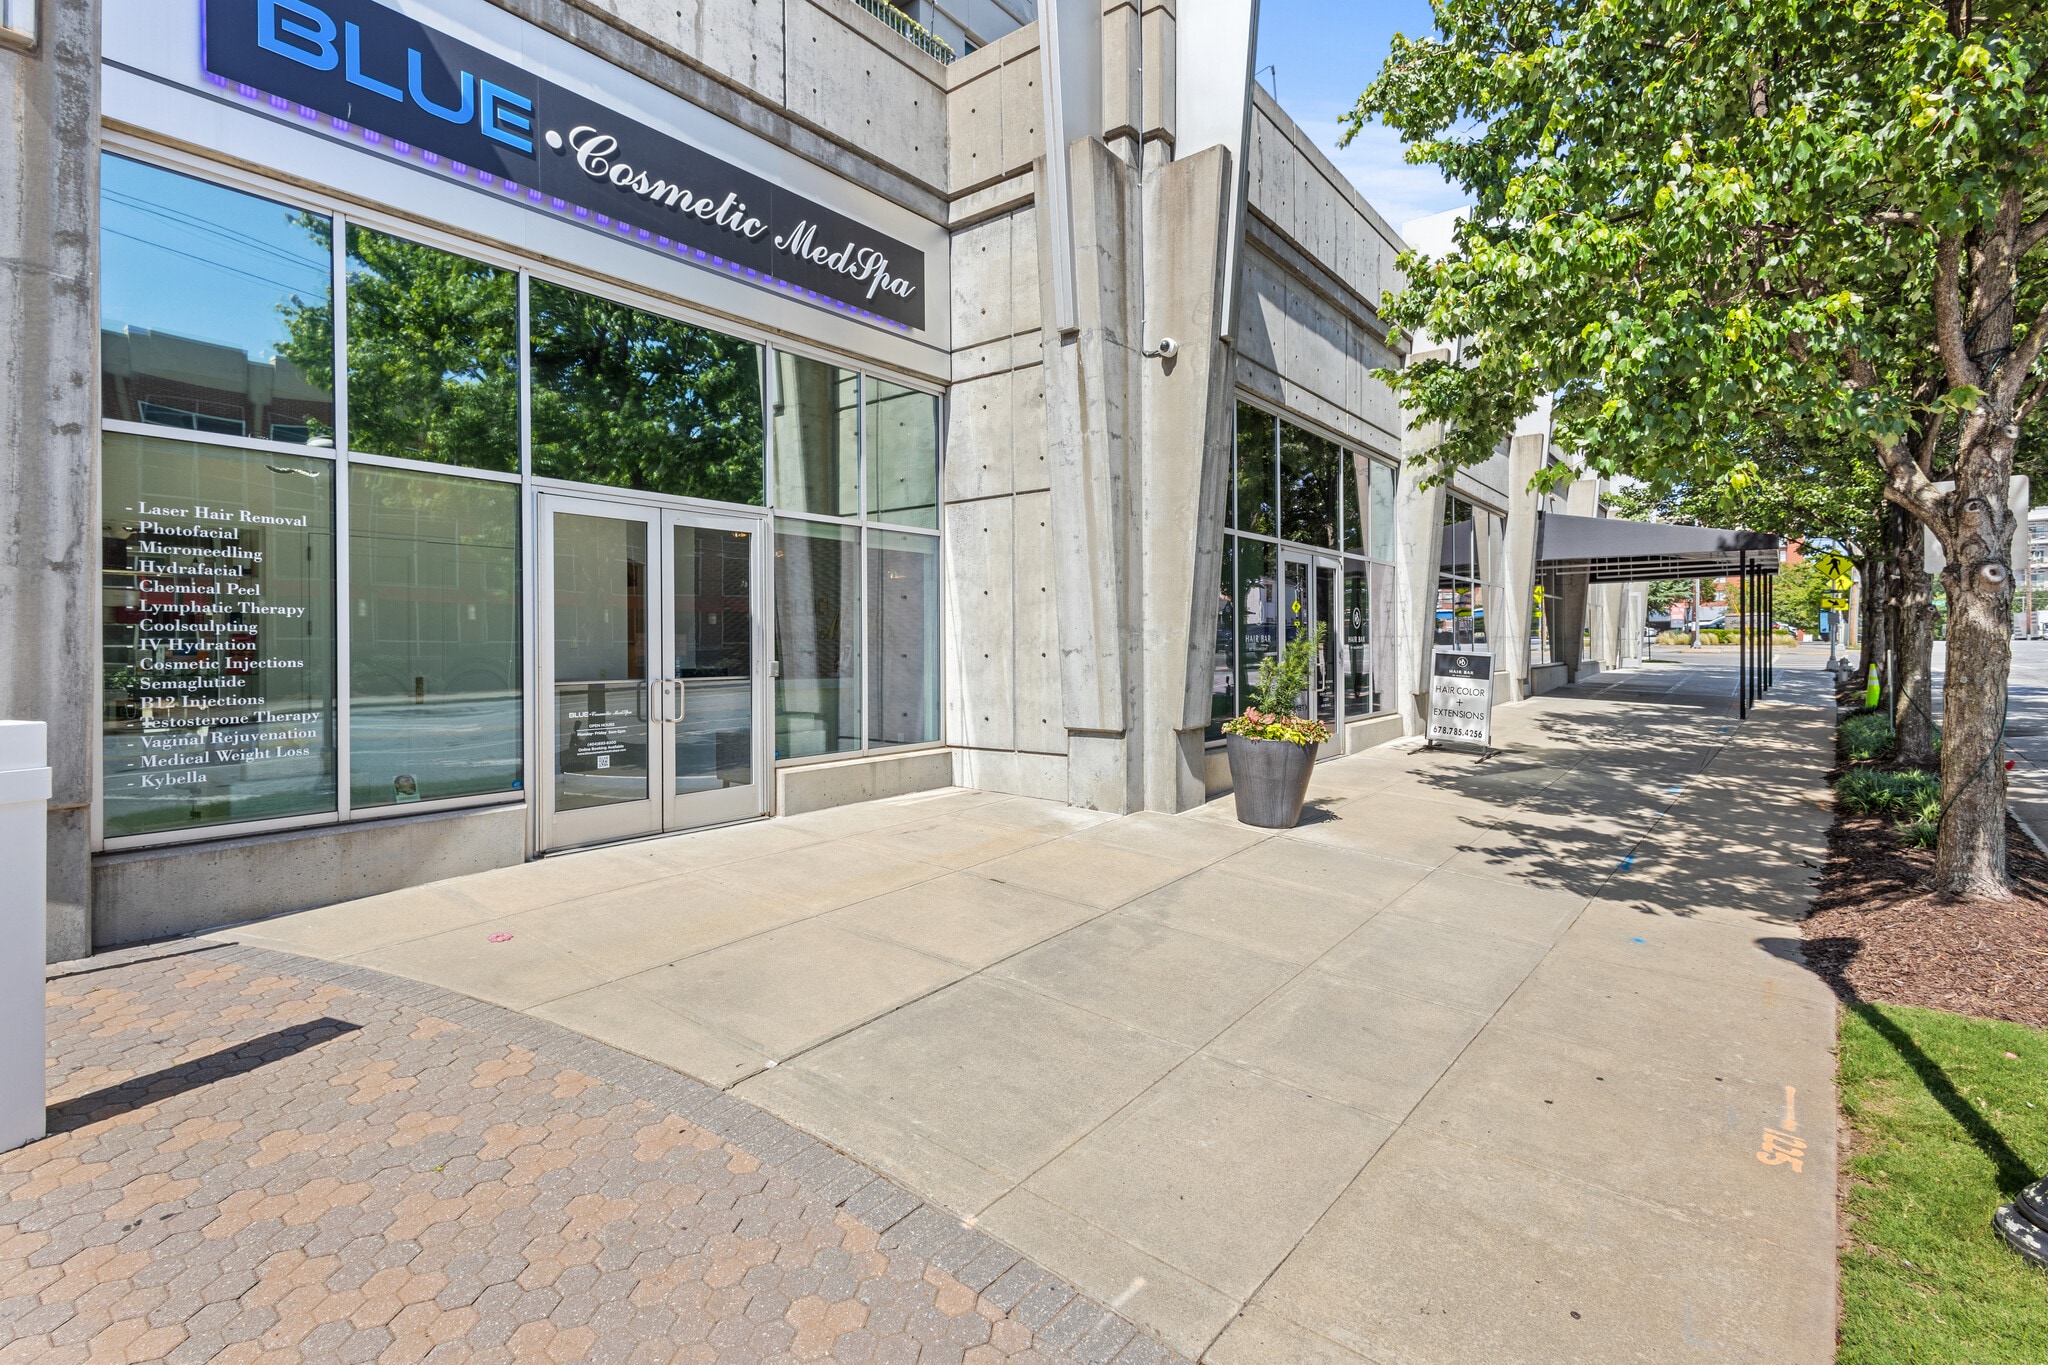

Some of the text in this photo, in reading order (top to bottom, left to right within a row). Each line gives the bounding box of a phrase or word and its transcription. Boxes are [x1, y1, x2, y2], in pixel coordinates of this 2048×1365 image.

[257, 0, 533, 153] BLUE
[569, 125, 768, 238] Cosmetic
[775, 221, 917, 298] MedSpa
[138, 502, 189, 517] Laser
[194, 506, 234, 521] Hair
[239, 510, 308, 527] Removal
[138, 521, 239, 540] Photofacial
[138, 541, 263, 563] Microneedling
[138, 560, 243, 577] Hydrafacial
[139, 579, 221, 595] Chemical
[226, 583, 261, 596] Peel
[139, 600, 233, 616] Lymphatic
[237, 601, 306, 618] Therapy
[139, 619, 258, 635] Coolsculpting
[139, 638, 163, 650] IV
[168, 638, 257, 654] Hydration
[1245, 634, 1272, 643] HAIR BAR
[139, 657, 220, 671] Cosmetic
[225, 656, 304, 672] Injections
[139, 675, 246, 691] Semaglutide
[1435, 685, 1485, 697] HAIR COLOR
[140, 696, 176, 710] B12
[181, 695, 265, 711] Injections
[140, 714, 249, 729] Testosterone
[253, 710, 320, 724] Therapy
[1433, 707, 1485, 720] EXTENSIONS
[141, 734, 206, 750] Vaginal
[210, 728, 317, 746] Rejuvenation
[1433, 725, 1483, 739] 678.785.4256
[140, 751, 210, 768] Medical
[215, 748, 271, 763] Weight
[276, 746, 310, 758] Loss
[141, 771, 208, 790] Kybella
